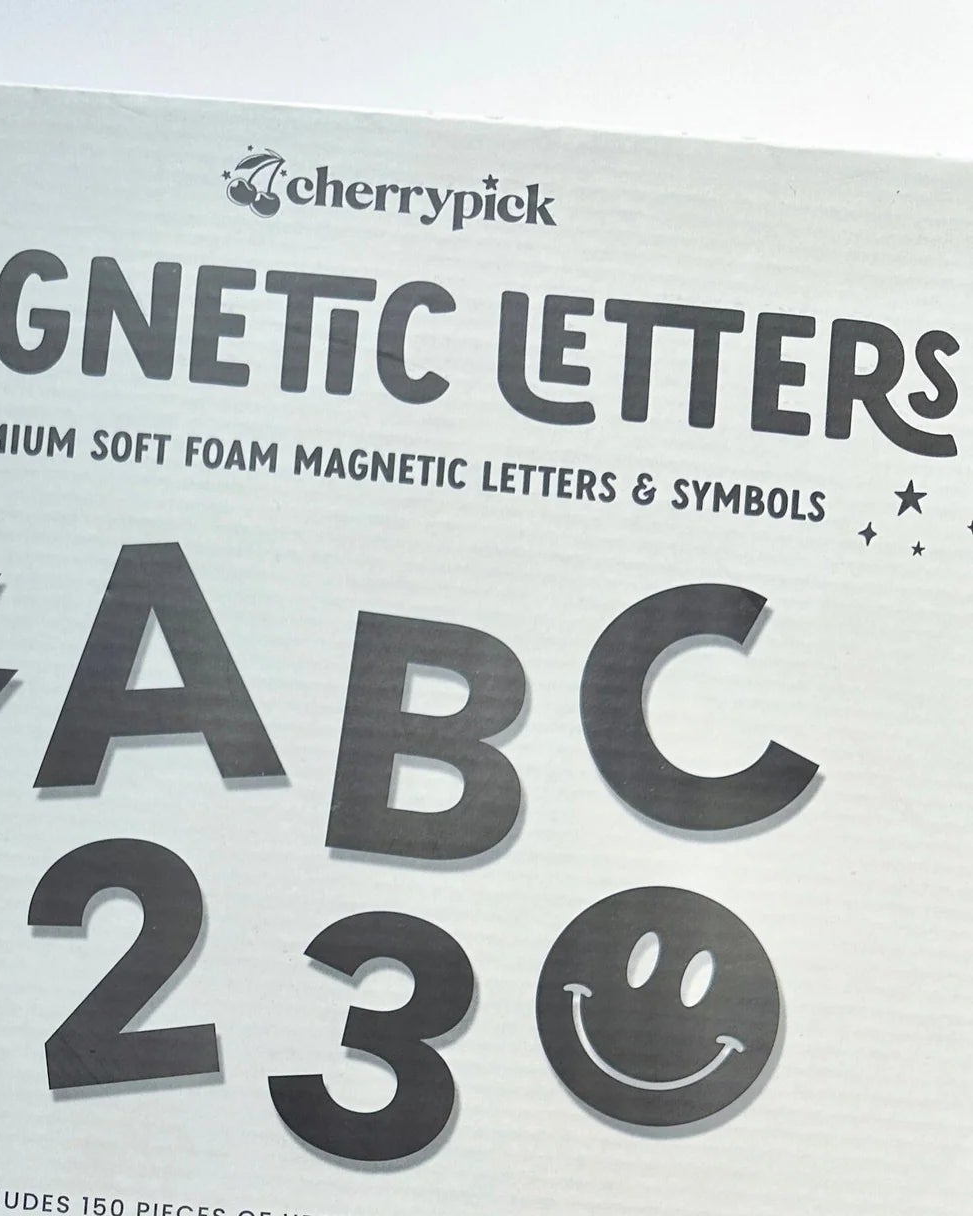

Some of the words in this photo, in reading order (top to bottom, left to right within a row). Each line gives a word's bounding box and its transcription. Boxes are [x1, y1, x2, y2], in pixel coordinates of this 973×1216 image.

[286, 165, 557, 231] cherrypick
[497, 290, 960, 458] LETTERS
[90, 429, 172, 467] SOFT
[185, 436, 278, 473] FOAM
[293, 444, 468, 492] MAGNETIC
[482, 460, 617, 503] LETTERS
[631, 472, 657, 506] &
[671, 478, 826, 523] SYMBOLS
